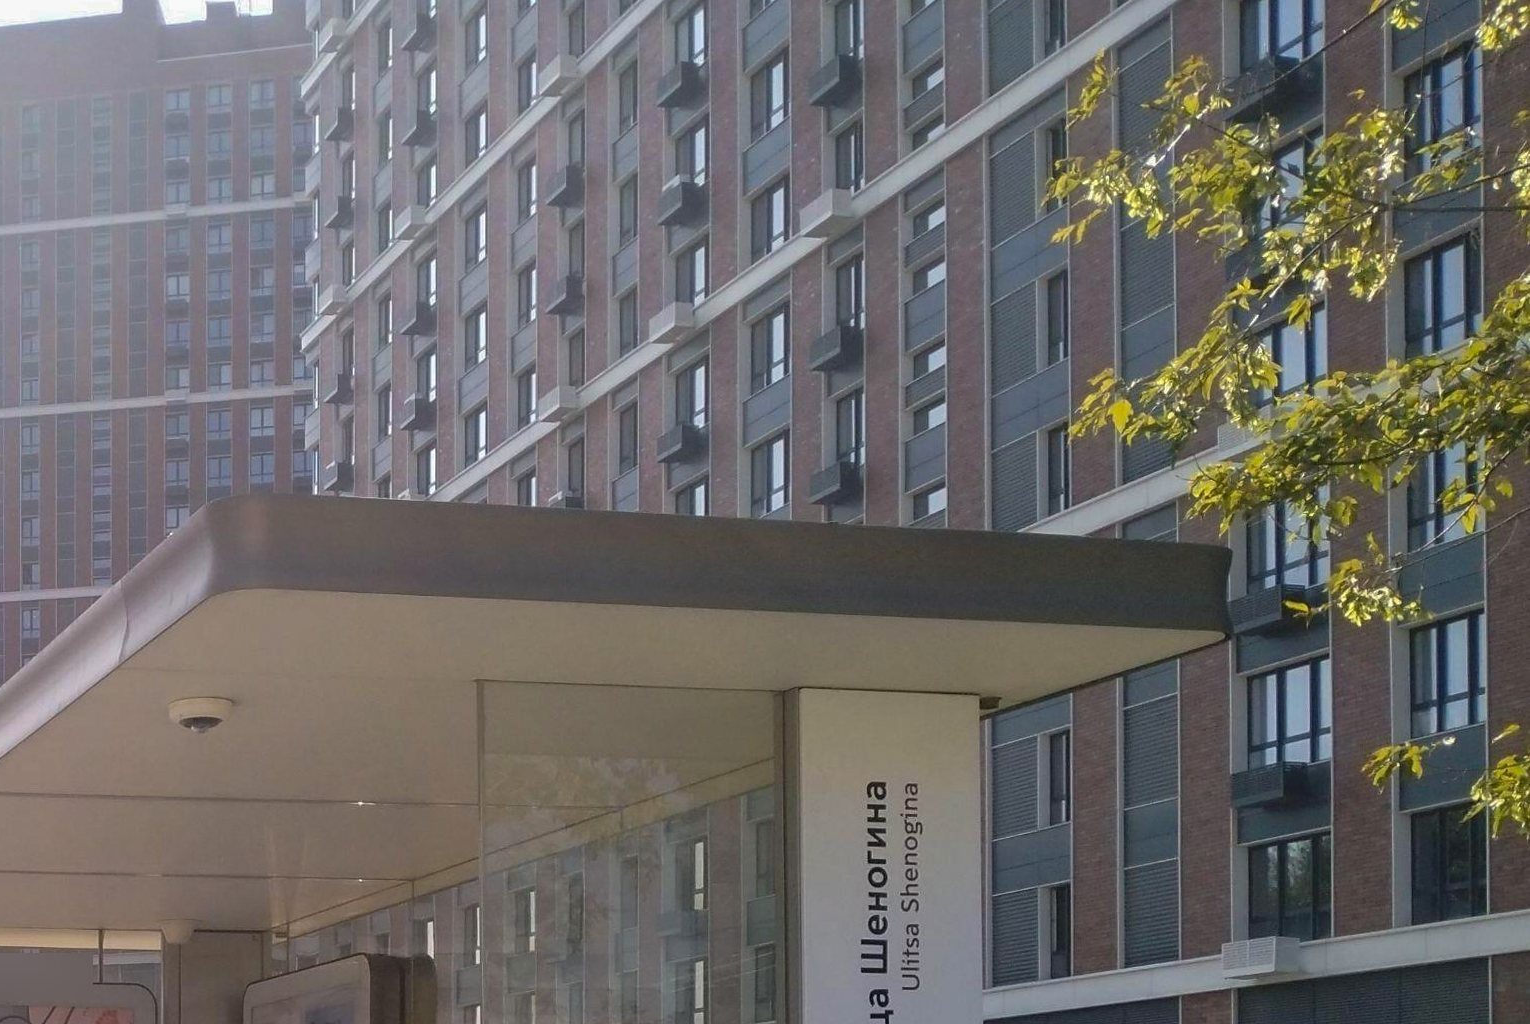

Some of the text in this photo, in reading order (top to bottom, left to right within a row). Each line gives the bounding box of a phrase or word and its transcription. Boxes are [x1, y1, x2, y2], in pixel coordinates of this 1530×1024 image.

[860, 780, 888, 975] Шеногина
[901, 781, 923, 992] Ulitsa Shenogina
